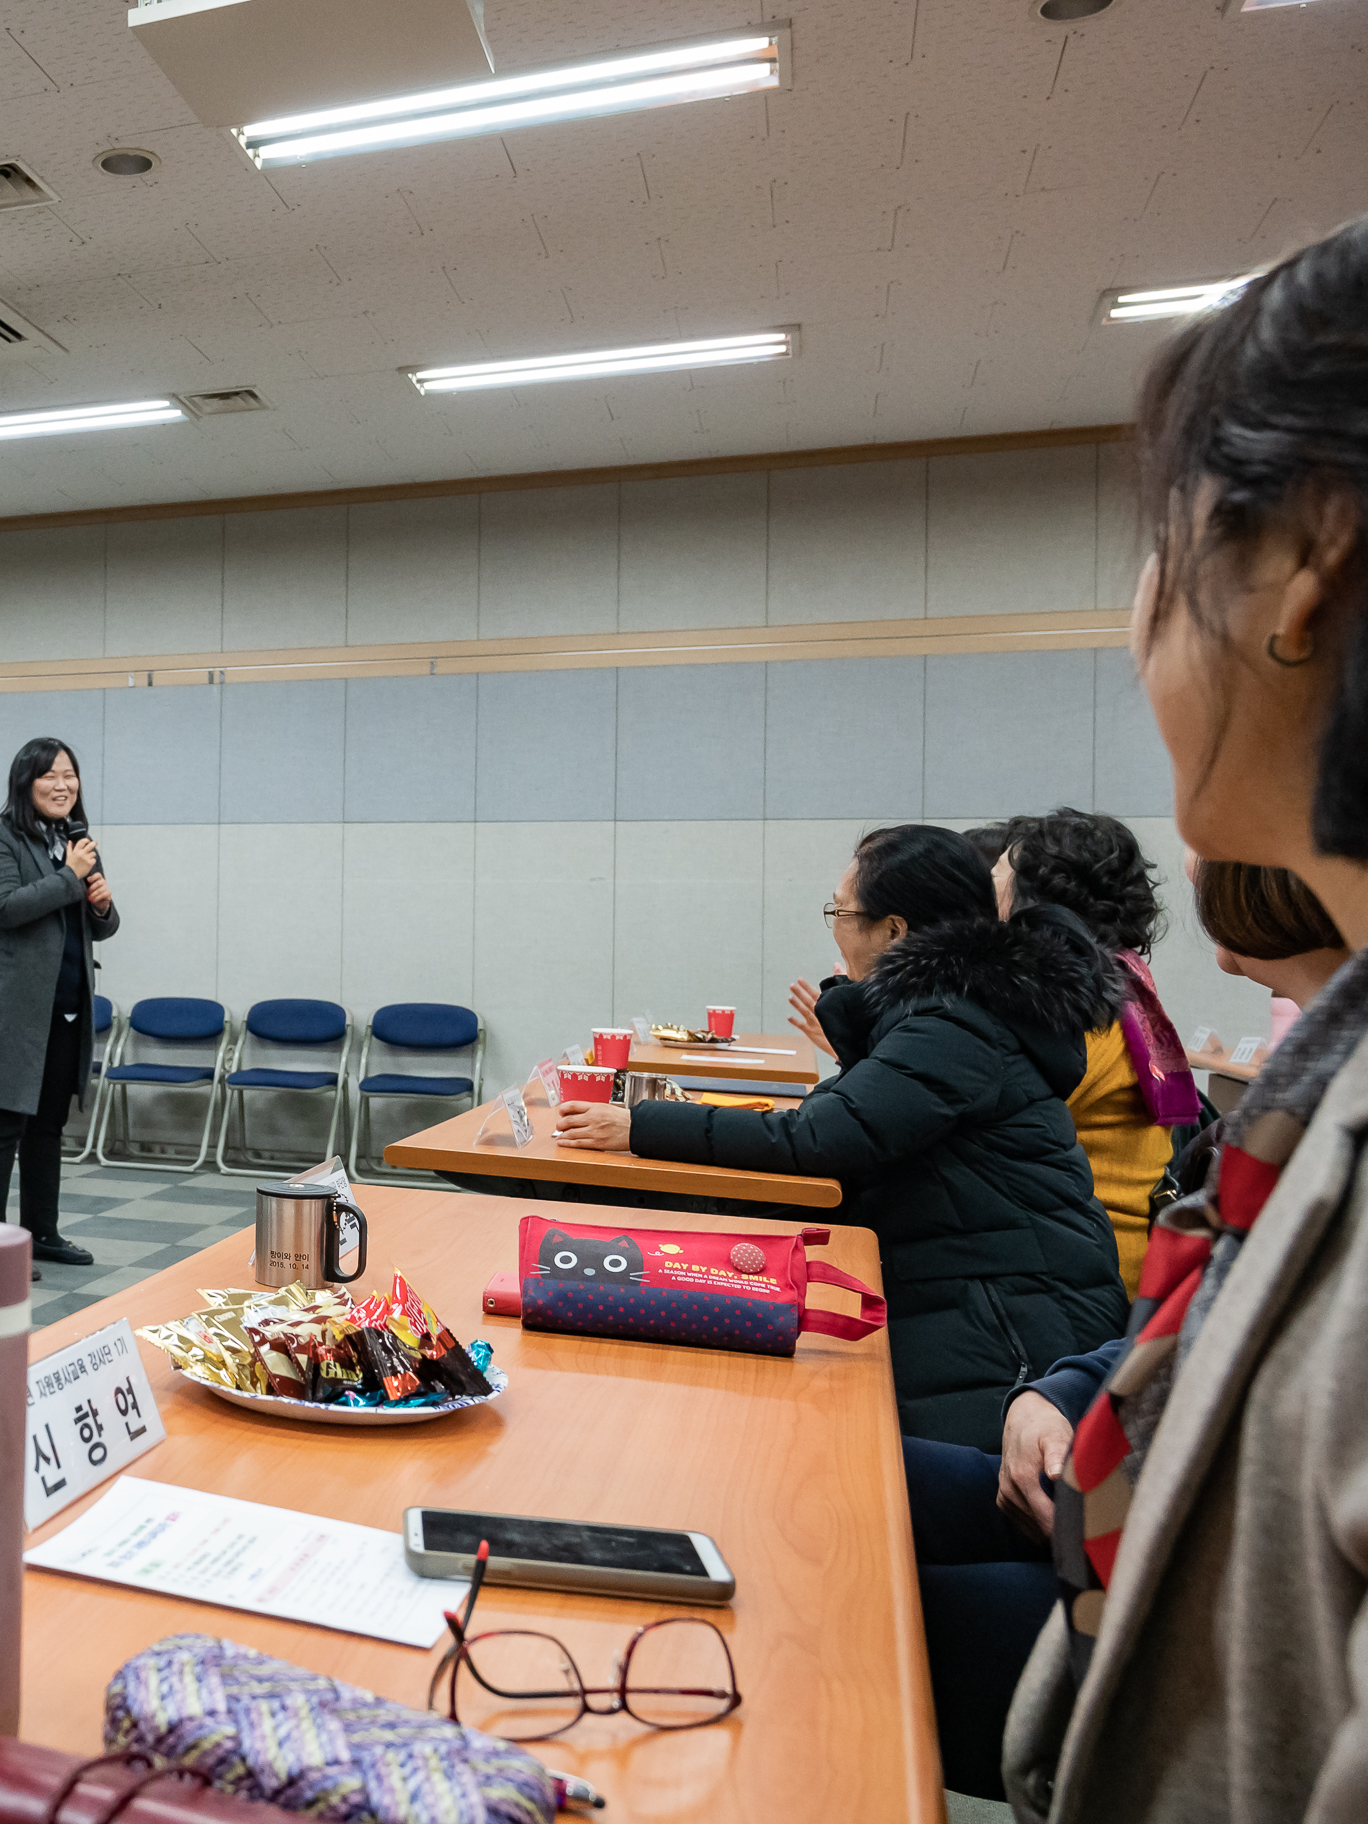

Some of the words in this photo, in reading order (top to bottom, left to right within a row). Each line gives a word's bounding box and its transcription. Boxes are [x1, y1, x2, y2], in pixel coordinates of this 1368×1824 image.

[269, 1260, 286, 1269] 2015.
[288, 1262, 299, 1270] 10.
[664, 1261, 689, 1270] DAY
[691, 1264, 707, 1273] BY
[741, 1273, 778, 1285] SMILE
[713, 1280, 741, 1289] EXPECTED
[35, 1358, 89, 1399] 자원봉사교육
[87, 1343, 114, 1372] 강사단
[114, 1336, 129, 1357] 1기
